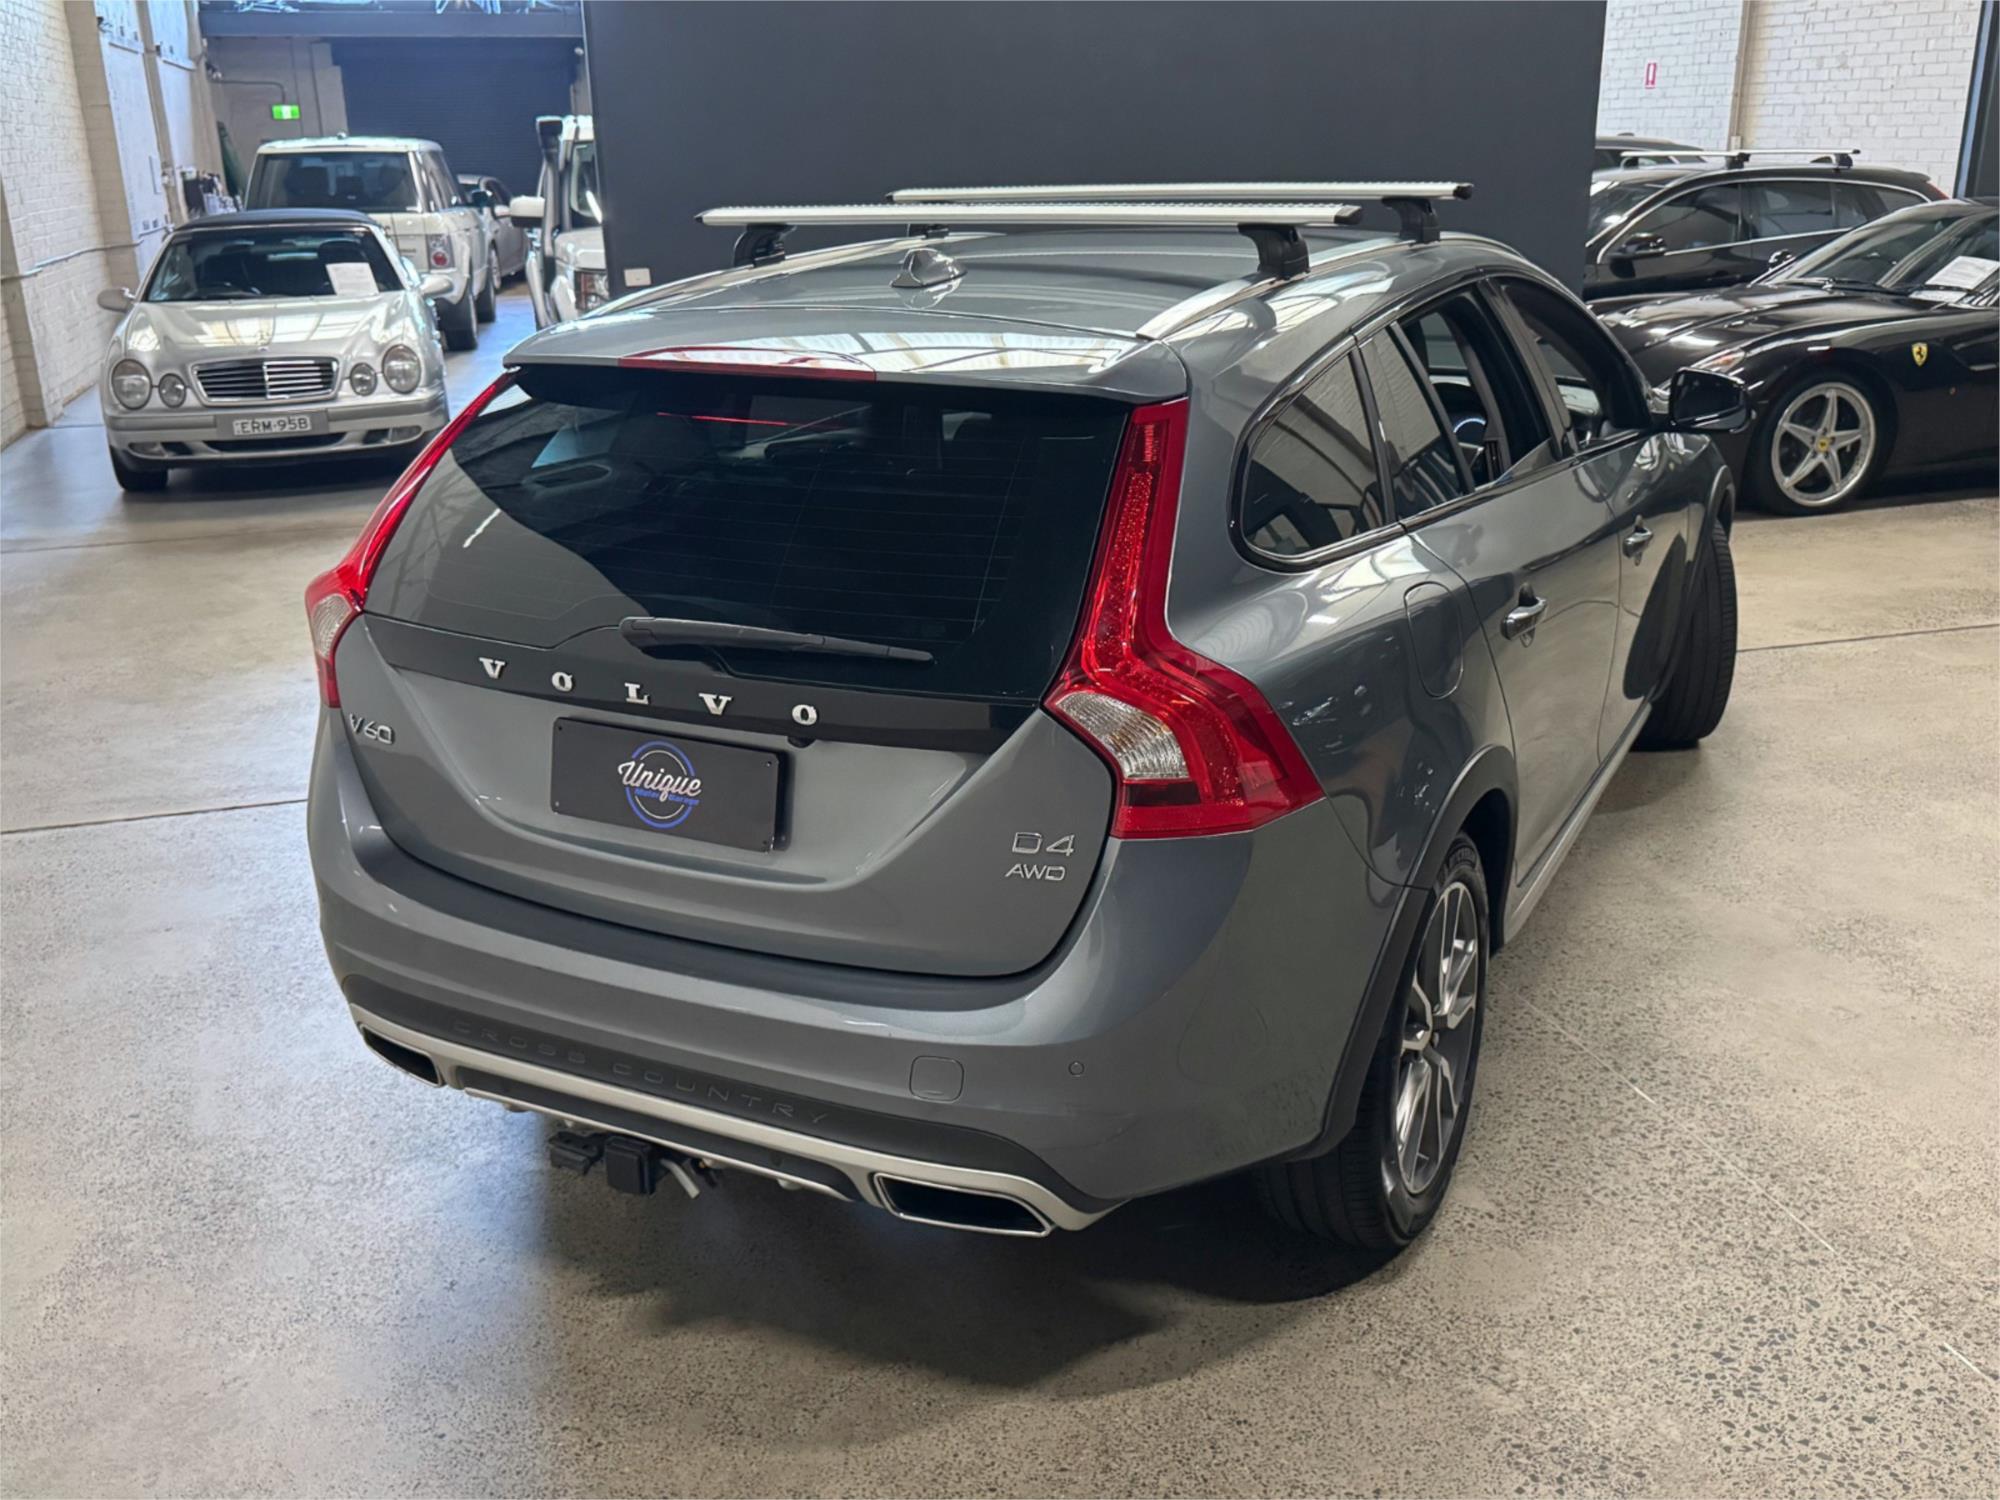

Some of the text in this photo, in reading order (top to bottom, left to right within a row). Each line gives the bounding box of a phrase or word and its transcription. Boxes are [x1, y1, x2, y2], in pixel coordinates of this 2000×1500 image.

[479, 657, 818, 726] VOLVO
[349, 713, 393, 744] V60
[617, 760, 702, 802] Unique
[1012, 831, 1075, 856] D4
[1004, 863, 1066, 881] AWD
[454, 1022, 828, 1124] CROSS COUNTRY
